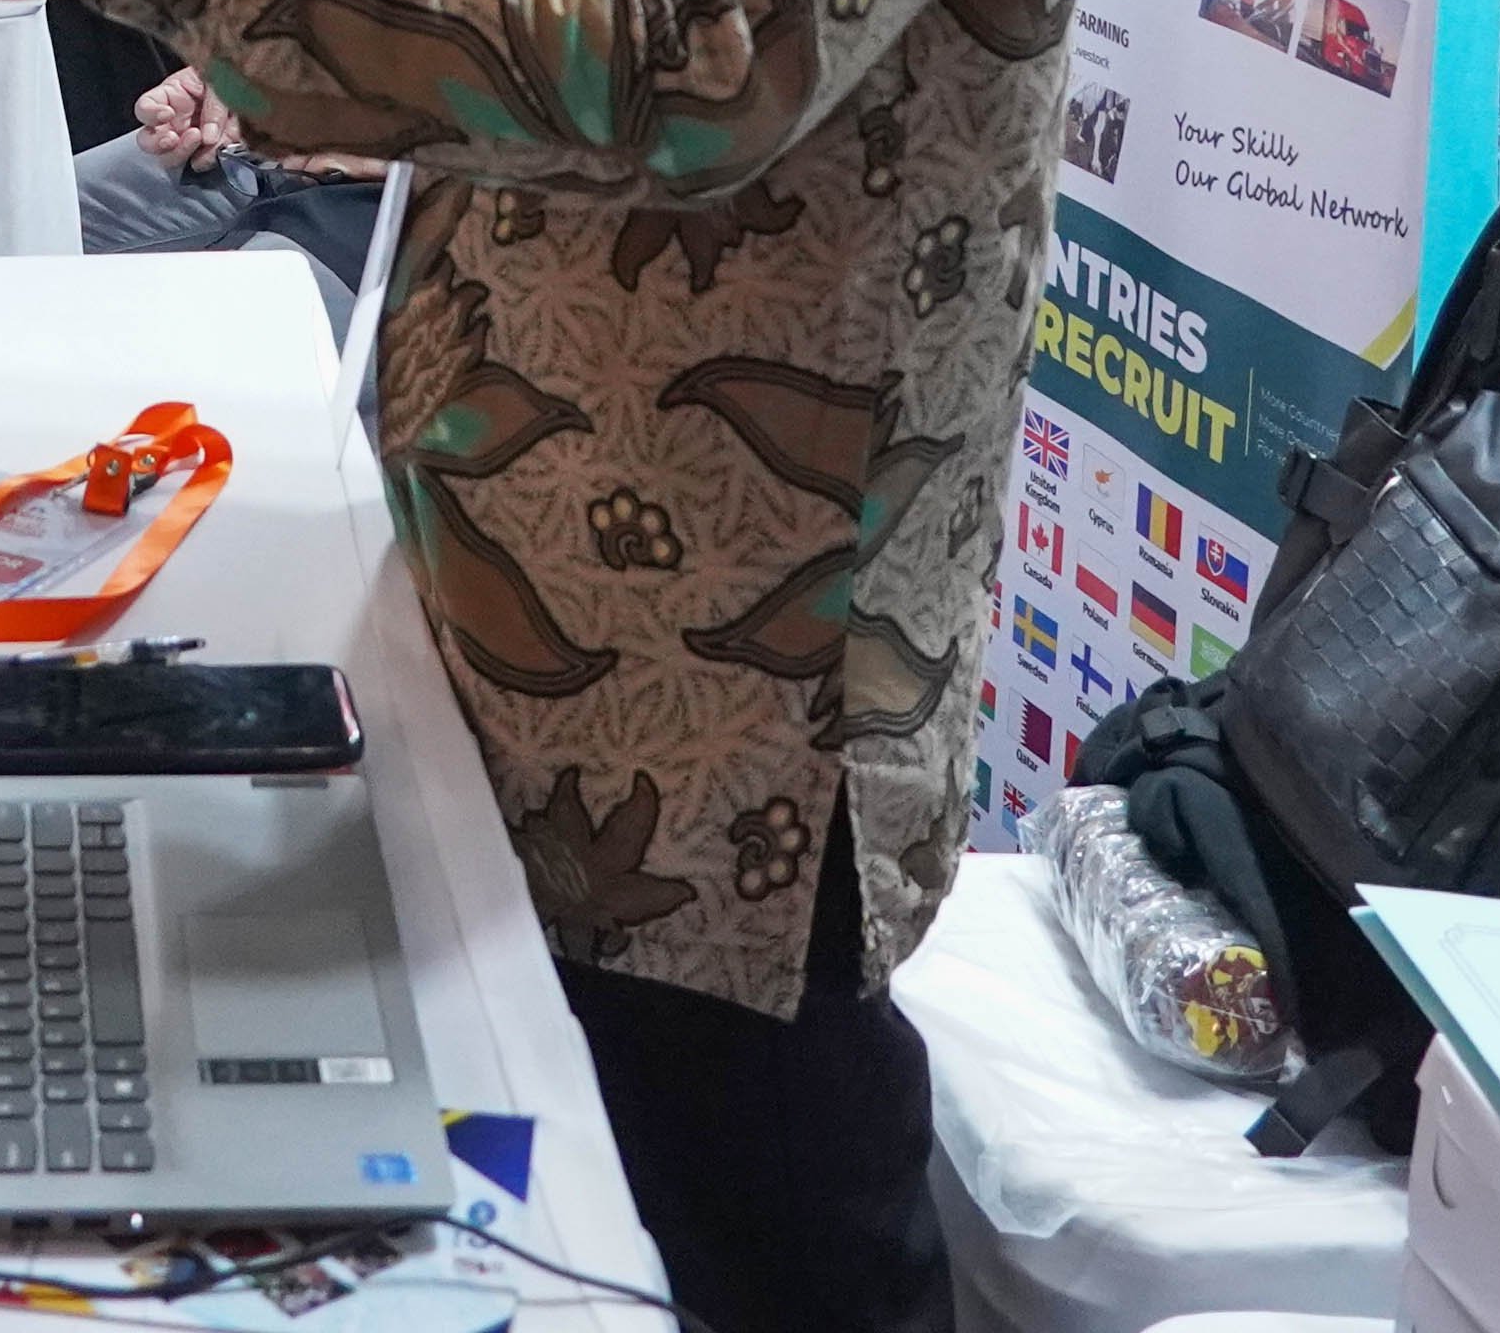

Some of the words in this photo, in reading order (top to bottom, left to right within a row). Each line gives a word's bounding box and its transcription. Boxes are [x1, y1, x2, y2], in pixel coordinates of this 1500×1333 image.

[1072, 45, 1112, 71] ivestock
[1174, 110, 1226, 149] Your
[1231, 125, 1300, 167] Skills
[1174, 159, 1220, 192] Our
[1226, 169, 1305, 212] Global
[1309, 188, 1410, 239] Network
[1046, 229, 1209, 375] NTRIES
[1035, 296, 1237, 465] RECRUIT
[1288, 403, 1341, 445] Countrie
[1024, 481, 1061, 515] Kingdom
[1029, 469, 1058, 496] United
[1087, 507, 1115, 536] Cyprus
[1022, 560, 1053, 591] Canada
[1138, 544, 1175, 580] Romania
[1082, 601, 1110, 632] Poland
[1200, 586, 1241, 623] Slovakia
[1016, 651, 1050, 685] Sweden
[1131, 641, 1170, 677] Germany
[1075, 694, 1101, 722] Finlan
[1015, 747, 1039, 773] Qatar
